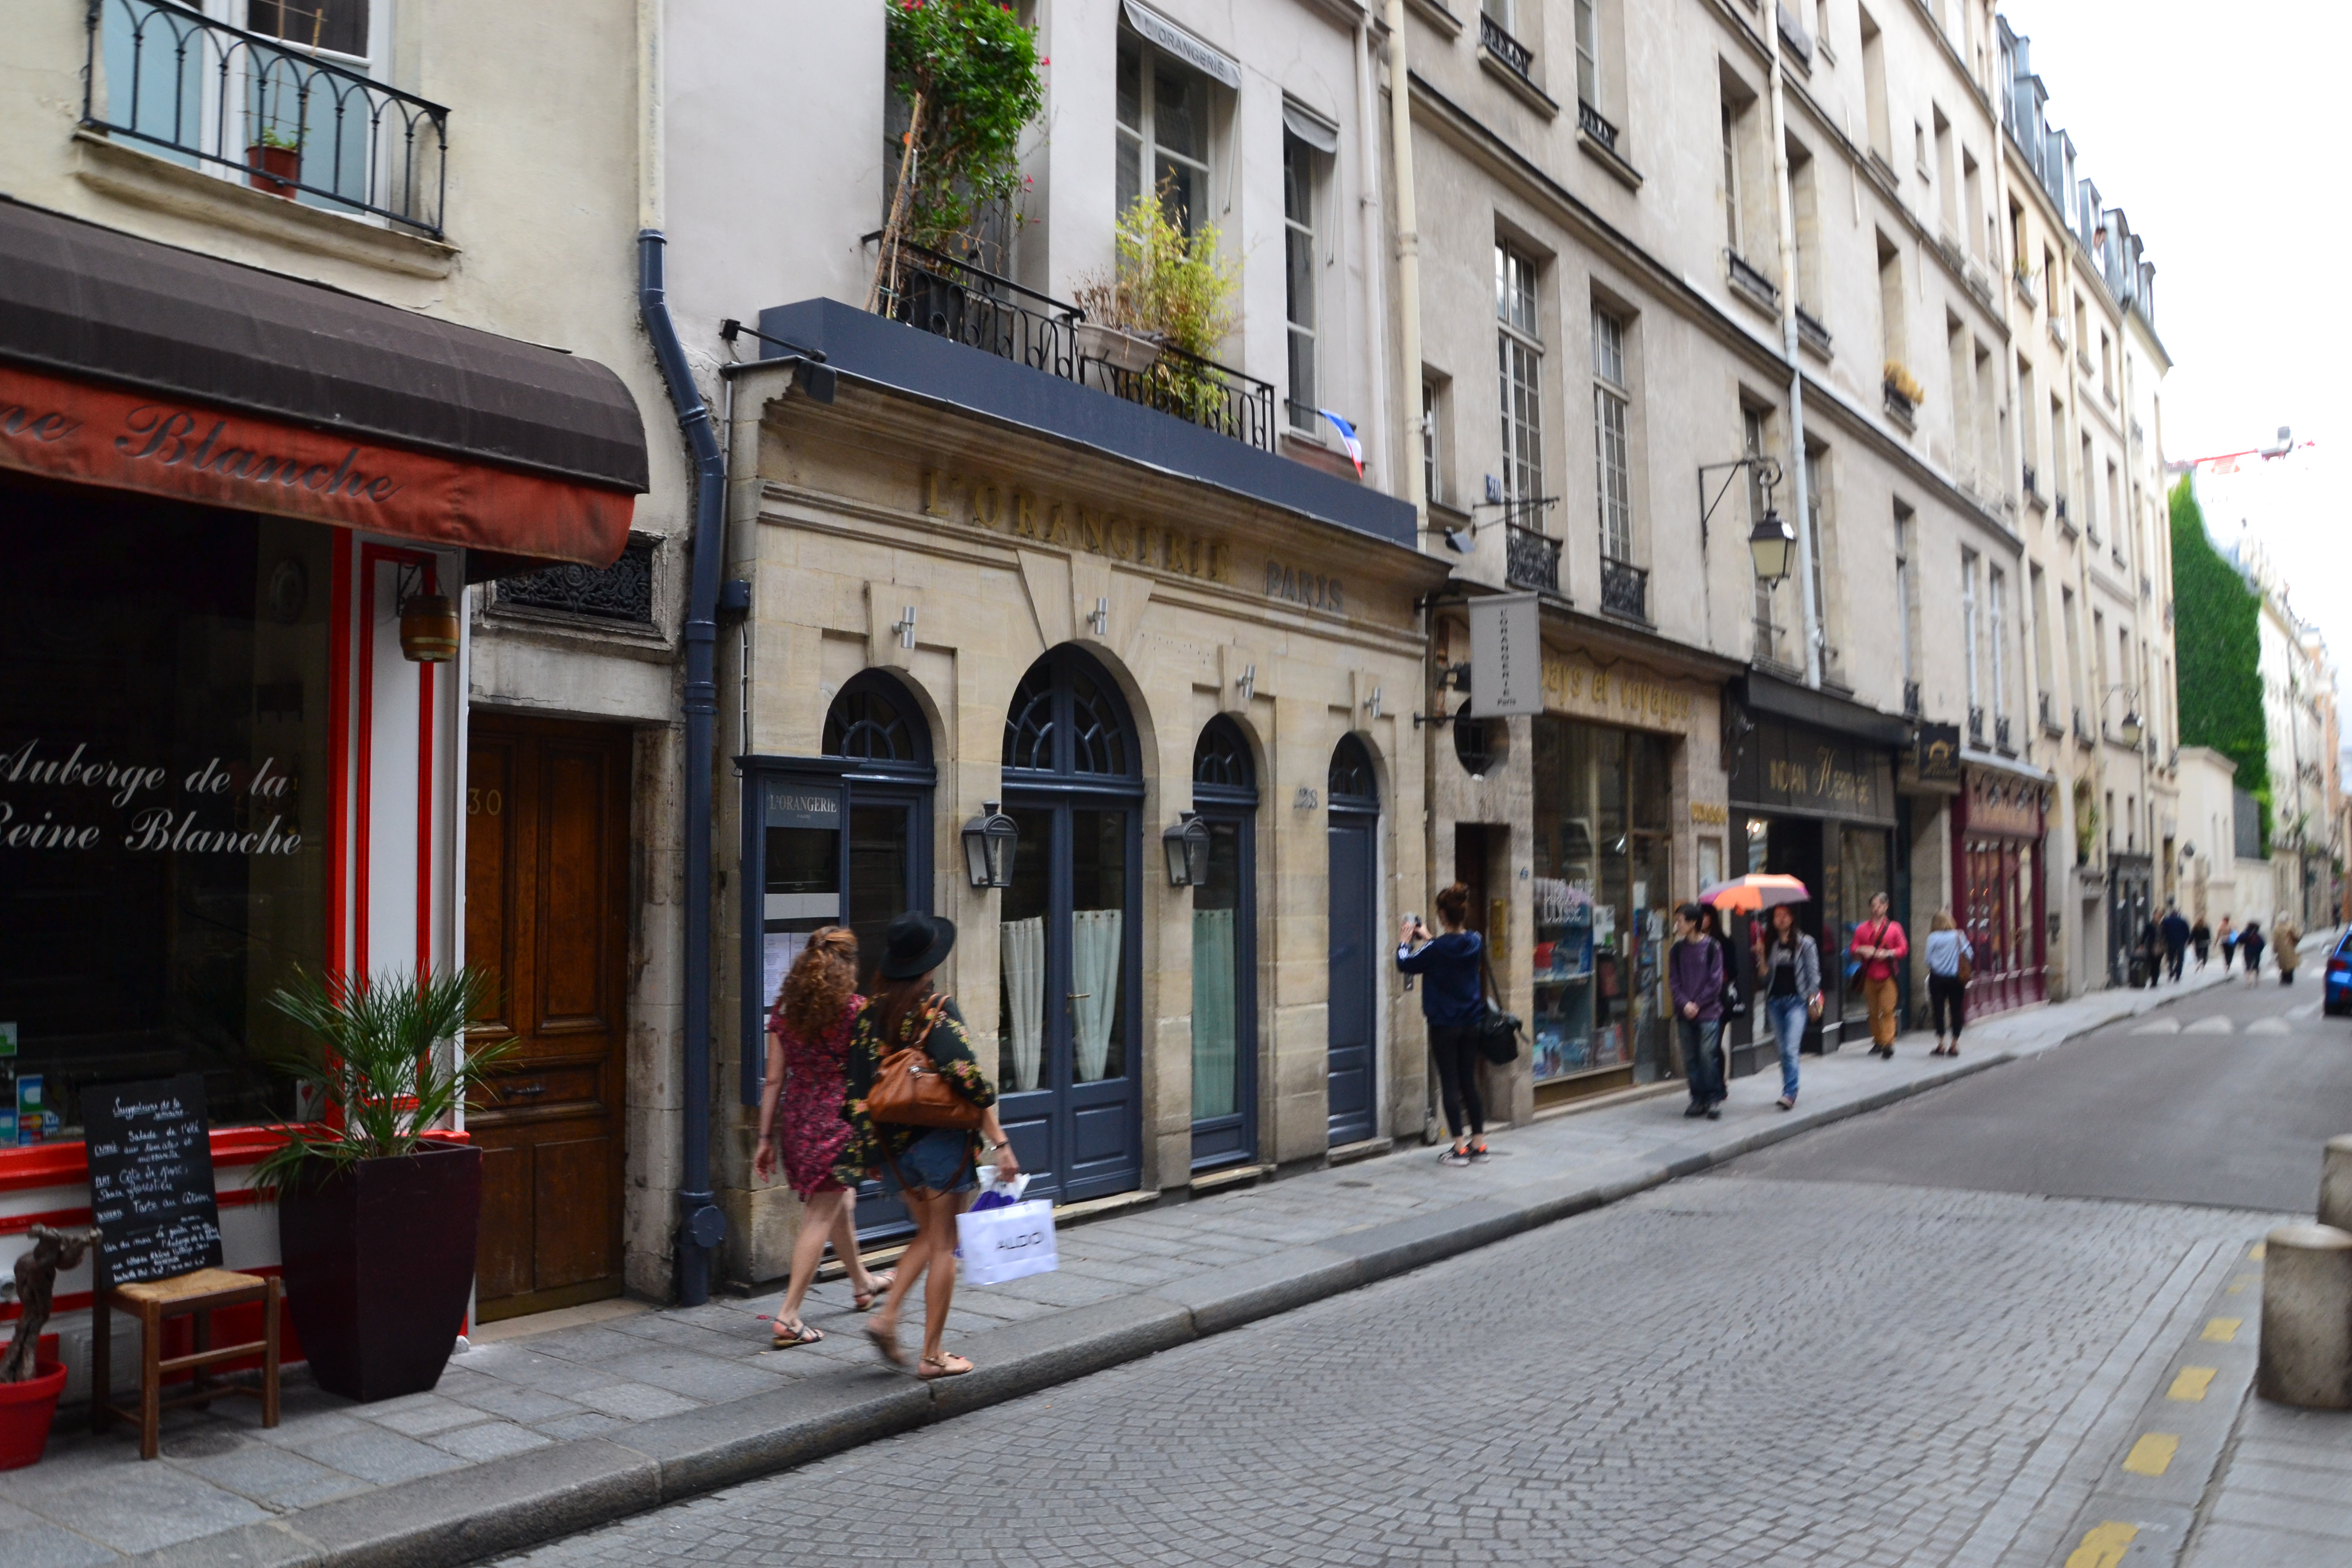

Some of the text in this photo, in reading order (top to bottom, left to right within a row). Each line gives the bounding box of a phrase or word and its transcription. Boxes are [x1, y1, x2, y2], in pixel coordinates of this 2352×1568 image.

[1144, 17, 1224, 77] L'ORANGERIE
[115, 407, 404, 502] Blanche
[924, 469, 1343, 613] L'ORANGERIE PARIS
[1542, 663, 1690, 727] ays et voyages
[0, 738, 288, 808] Auberge de la
[467, 787, 502, 816] 30
[769, 794, 837, 813] L'ORANGERIE
[0, 801, 302, 854] eine Blanche
[113, 1096, 182, 1120] Suggestions de la
[129, 1129, 158, 1142] Salade
[166, 1126, 177, 1137] de
[145, 1164, 155, 1179] de
[133, 1199, 159, 1213] Tarte
[162, 1199, 178, 1208] au
[994, 1232, 1045, 1252] ALDO
